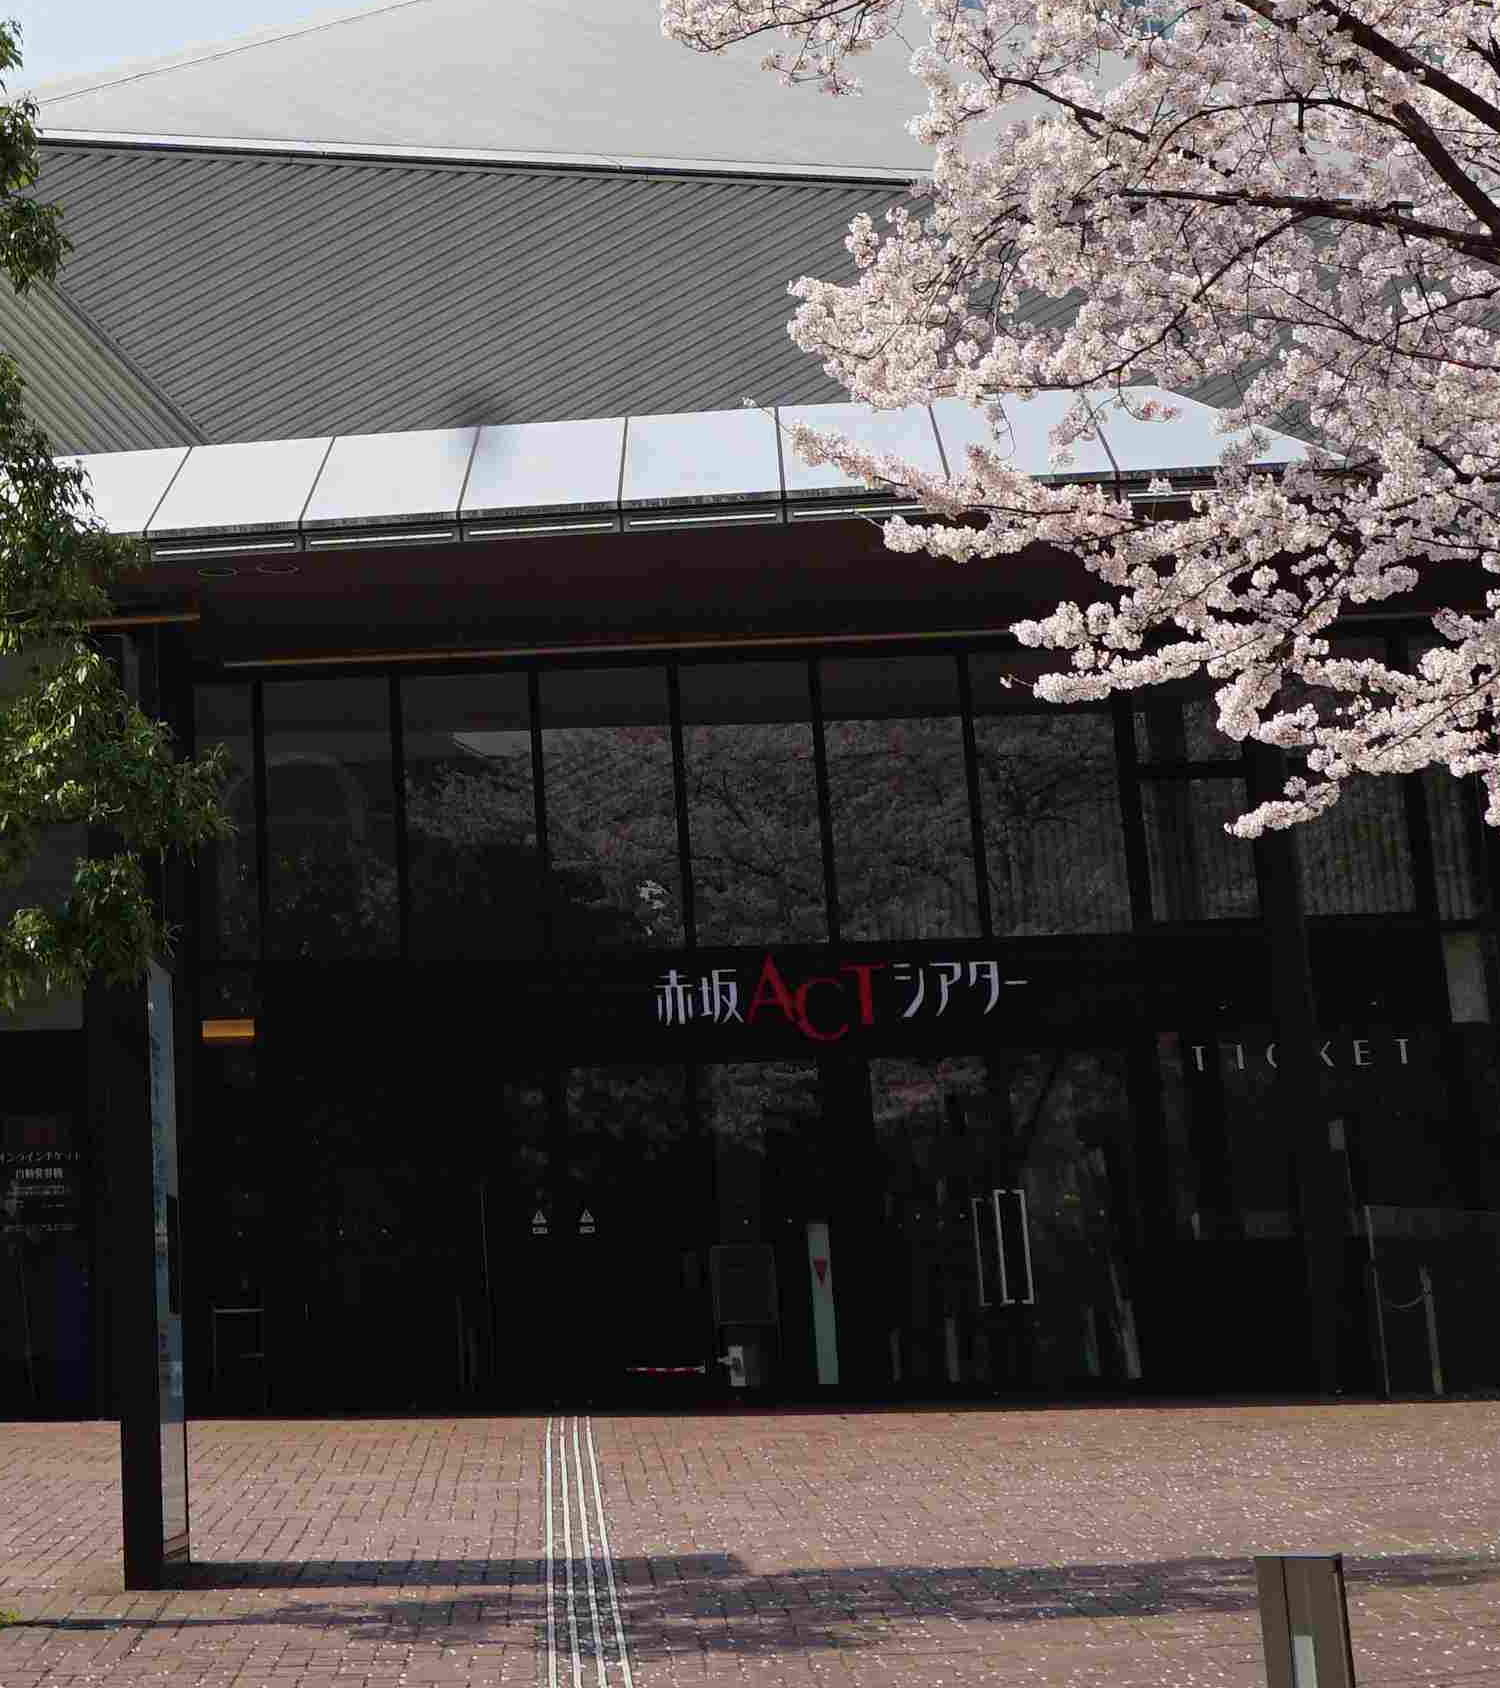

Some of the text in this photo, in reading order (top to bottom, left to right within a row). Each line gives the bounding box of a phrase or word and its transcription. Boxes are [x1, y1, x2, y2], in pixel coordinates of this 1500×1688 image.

[654, 953, 1028, 1041] 赤坂ACTシアター
[1191, 1037, 1409, 1072] TICKET
